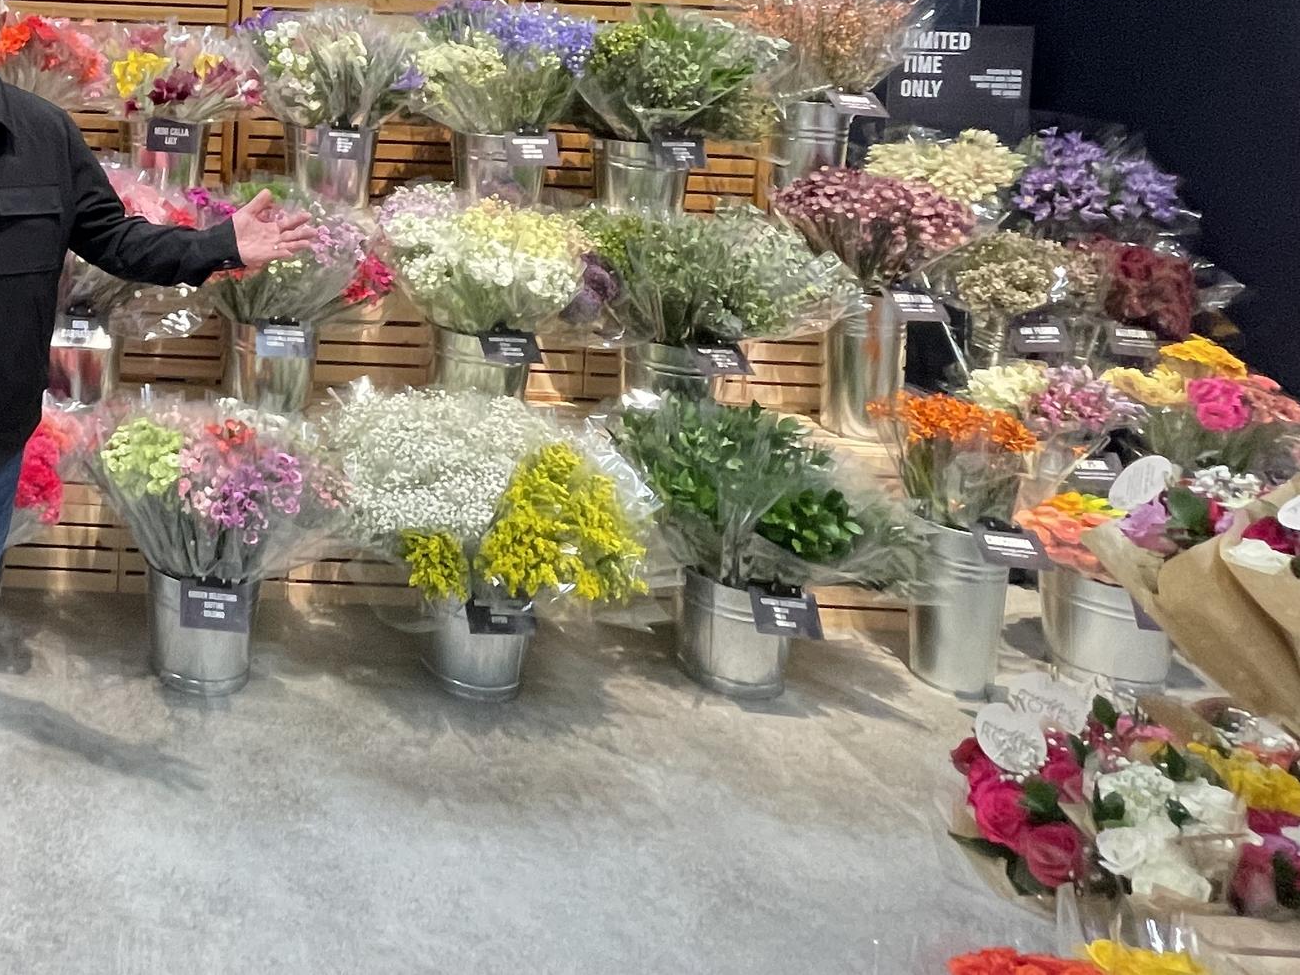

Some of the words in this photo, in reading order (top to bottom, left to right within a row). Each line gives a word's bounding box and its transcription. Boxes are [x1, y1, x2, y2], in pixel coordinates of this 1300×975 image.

[902, 31, 971, 51] LIMITED
[903, 55, 943, 74] TIME
[900, 79, 943, 98] ONLY
